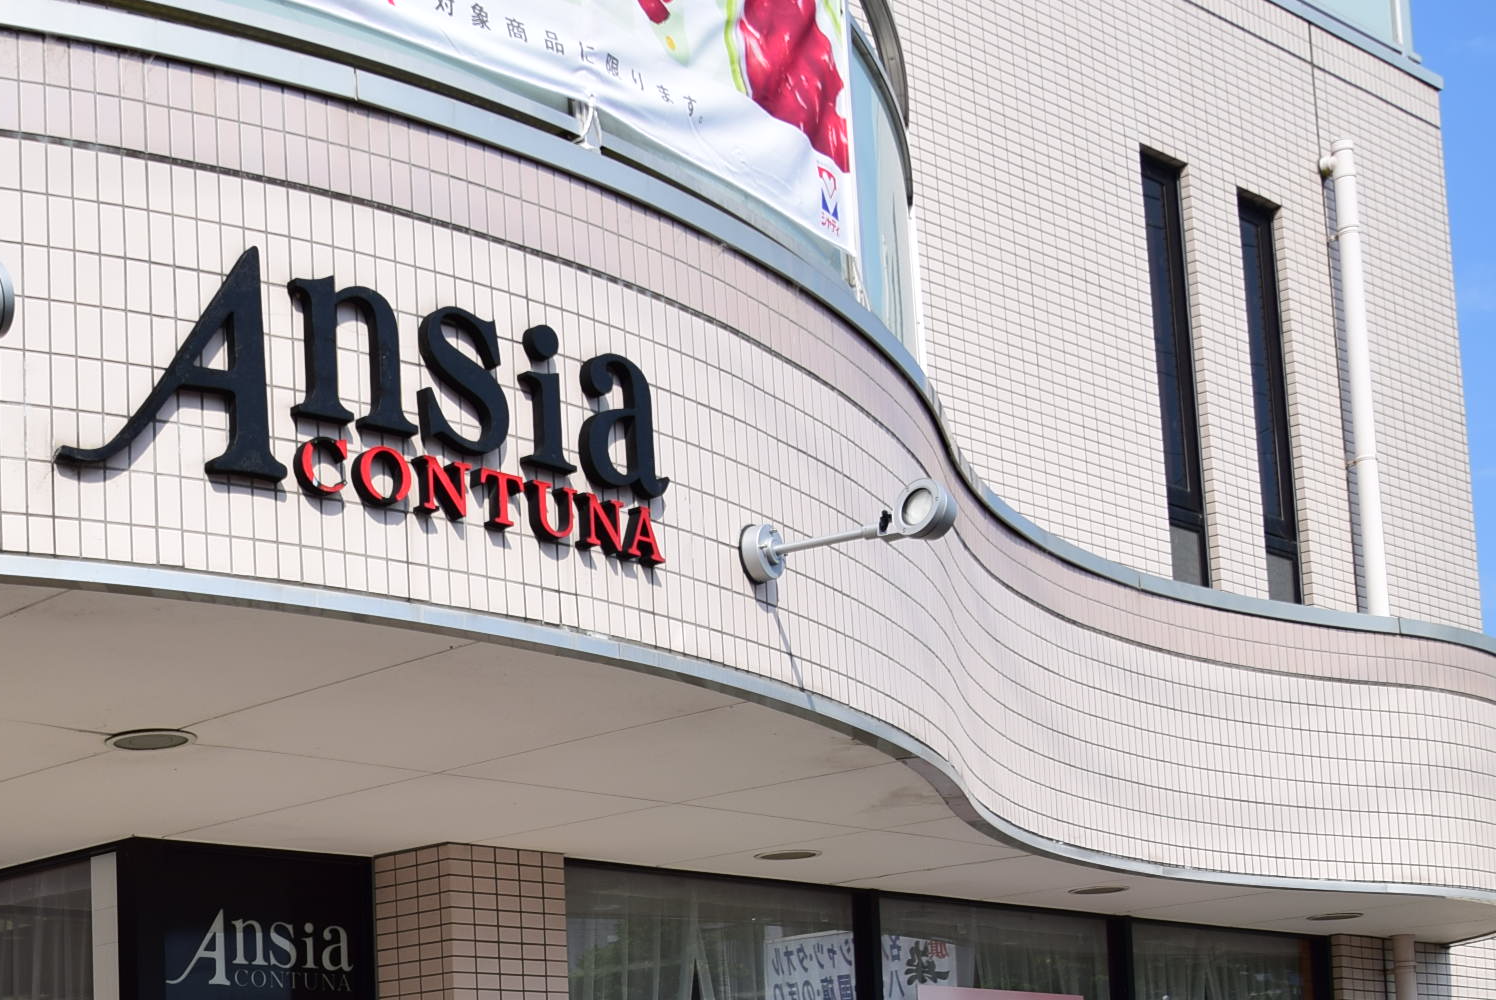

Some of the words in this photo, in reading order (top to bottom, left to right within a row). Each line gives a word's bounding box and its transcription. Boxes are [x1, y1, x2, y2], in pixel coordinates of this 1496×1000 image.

[435, 0, 704, 125] 対象商品に限ります。
[53, 245, 668, 500] Ansia
[294, 435, 666, 567] CONTUNA
[165, 908, 354, 986] Ansia
[234, 968, 352, 992] CONTUNA
